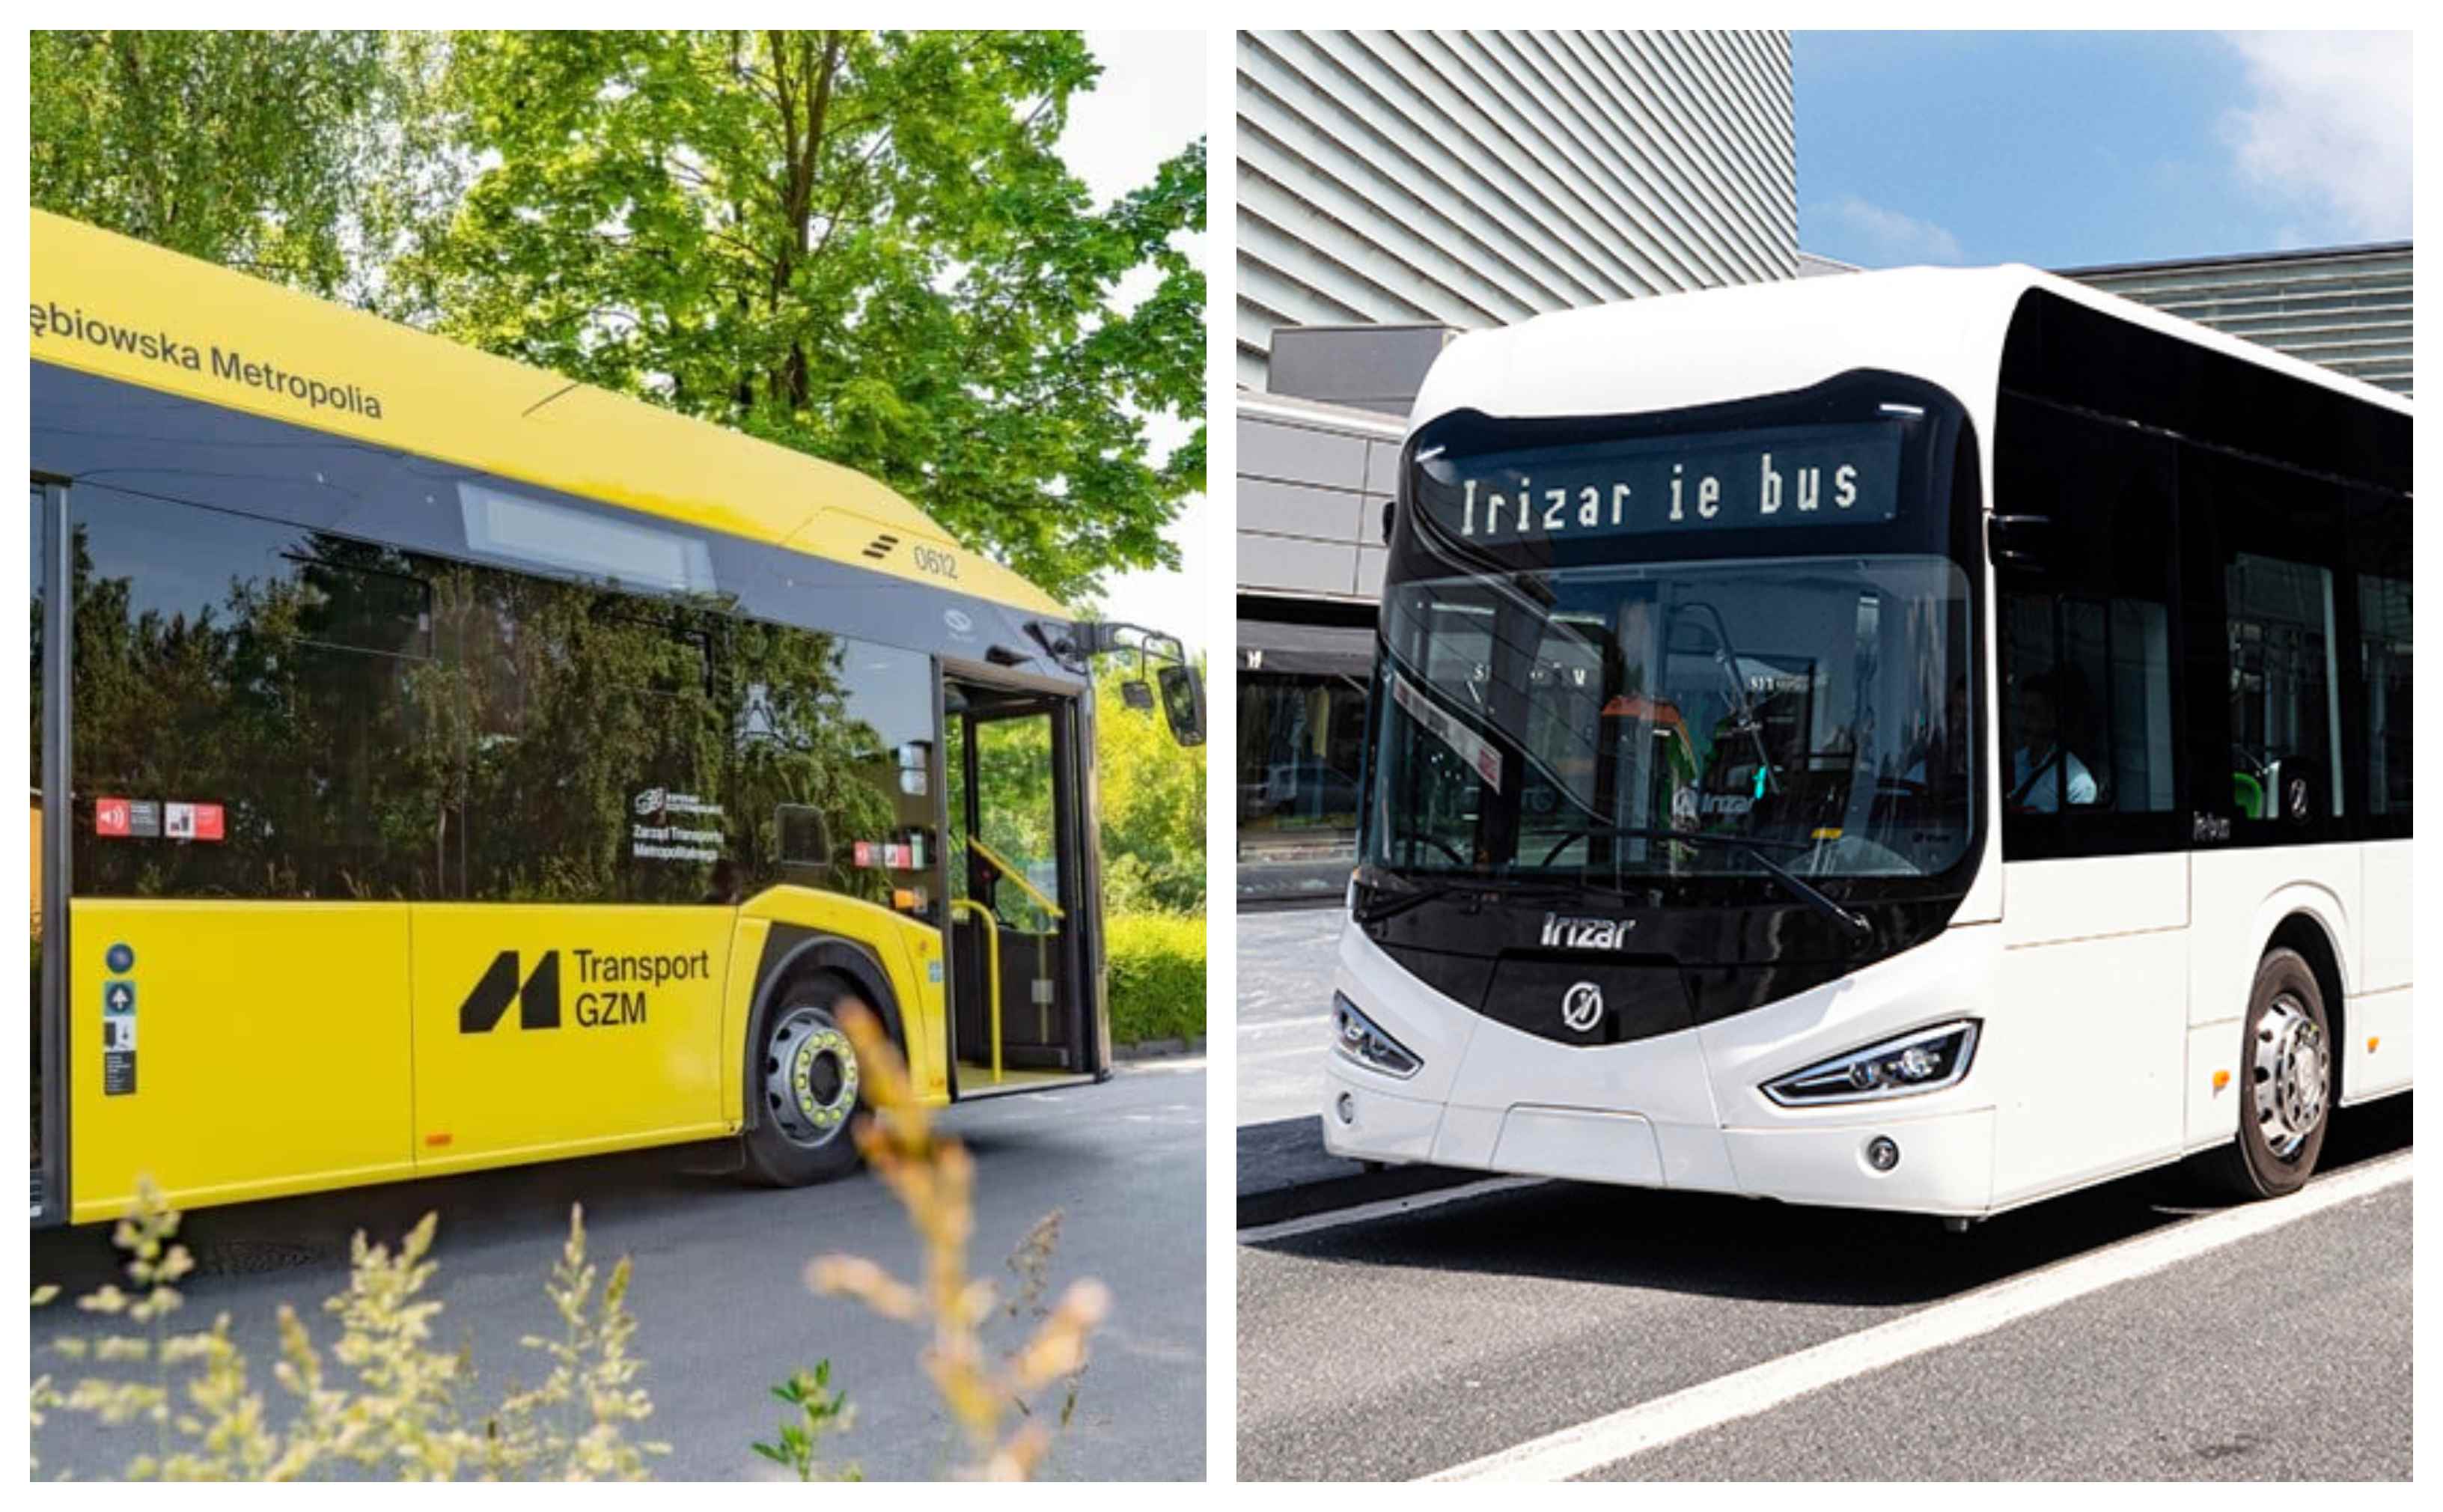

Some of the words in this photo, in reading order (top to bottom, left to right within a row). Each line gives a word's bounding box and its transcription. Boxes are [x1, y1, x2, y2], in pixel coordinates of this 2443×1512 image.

[210, 345, 382, 419] Metropolia
[1462, 479, 1632, 536] Irizar
[1669, 464, 1720, 520] ie
[1760, 454, 1858, 514] bus
[914, 545, 958, 579] 0612
[573, 949, 710, 987] Transport
[576, 991, 646, 1027] GZM
